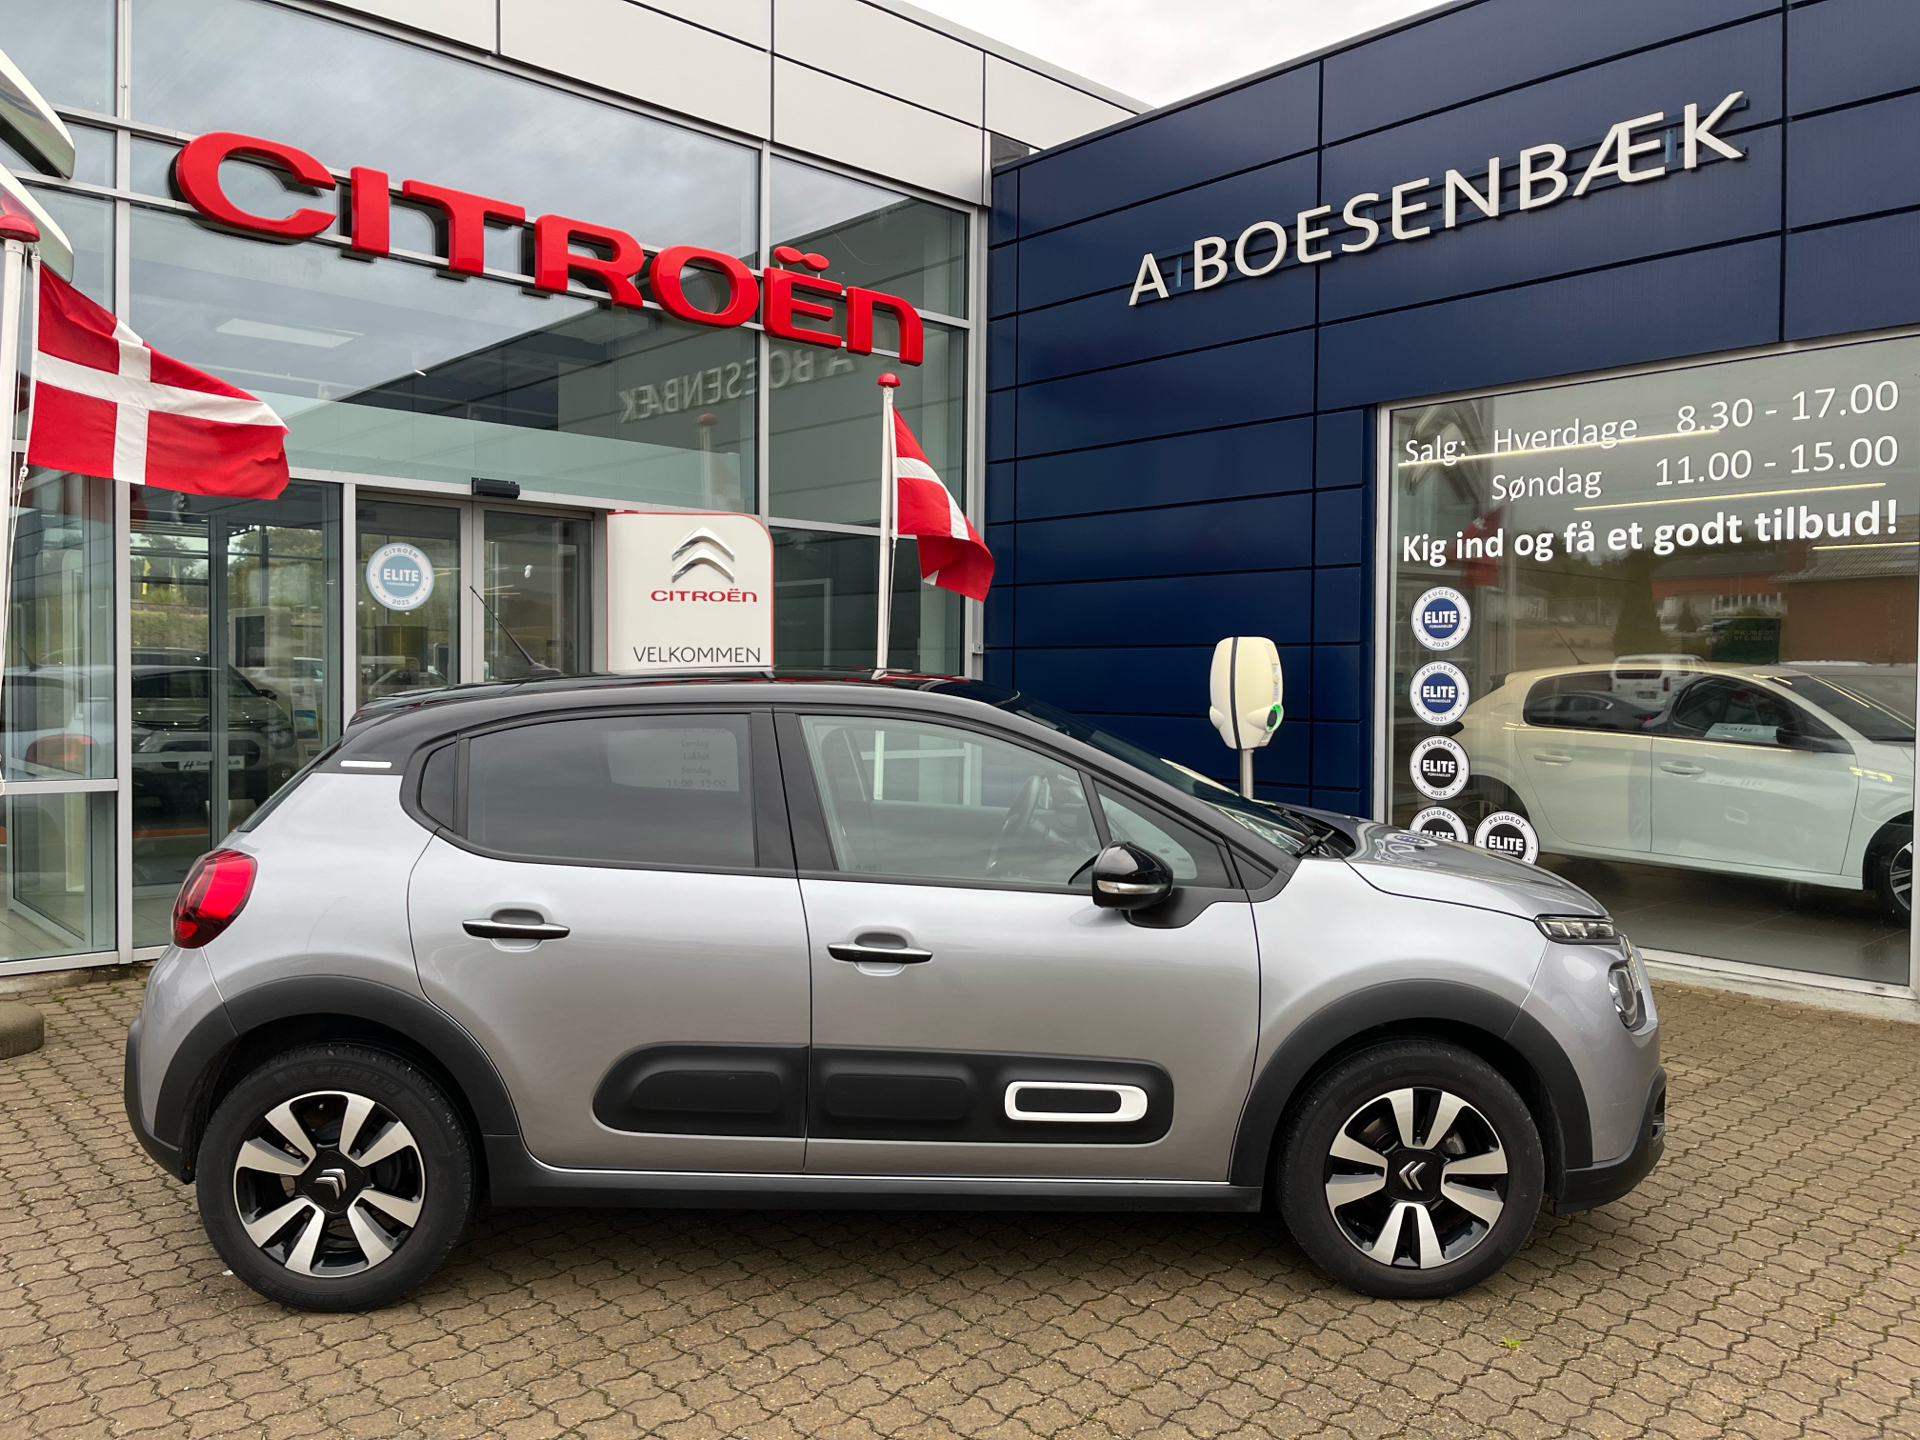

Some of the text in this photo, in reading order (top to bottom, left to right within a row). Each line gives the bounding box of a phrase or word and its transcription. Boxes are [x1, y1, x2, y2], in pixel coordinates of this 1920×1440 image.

[1129, 90, 1744, 306] A BOESENBÆK
[173, 132, 924, 366] CITROËN
[1405, 437, 1467, 467] Salg:
[1493, 418, 1638, 452] Hverdage
[1676, 397, 1754, 434] 8.30
[1790, 380, 1899, 422] 17.00
[1491, 466, 1603, 502] Søndag
[1655, 449, 1753, 487] 11.00
[1790, 435, 1899, 475] 15.00
[1403, 499, 1898, 568] Kig ind og få et godt tilbud!
[383, 568, 420, 582] ELITE
[650, 588, 758, 603] CITROËN
[1423, 589, 1460, 602] PEUGEOT
[1424, 610, 1458, 624] ELITE
[632, 646, 761, 663] VELKOMMEN
[1421, 664, 1458, 677] PEUGEOT
[1422, 685, 1456, 698] ELITE
[1422, 739, 1457, 751] PEUGEOT
[1422, 759, 1456, 773] ELITE
[1421, 810, 1457, 822] PEUGEOT
[1488, 815, 1526, 828] PEUGEOT
[1488, 835, 1524, 851] ELITE
